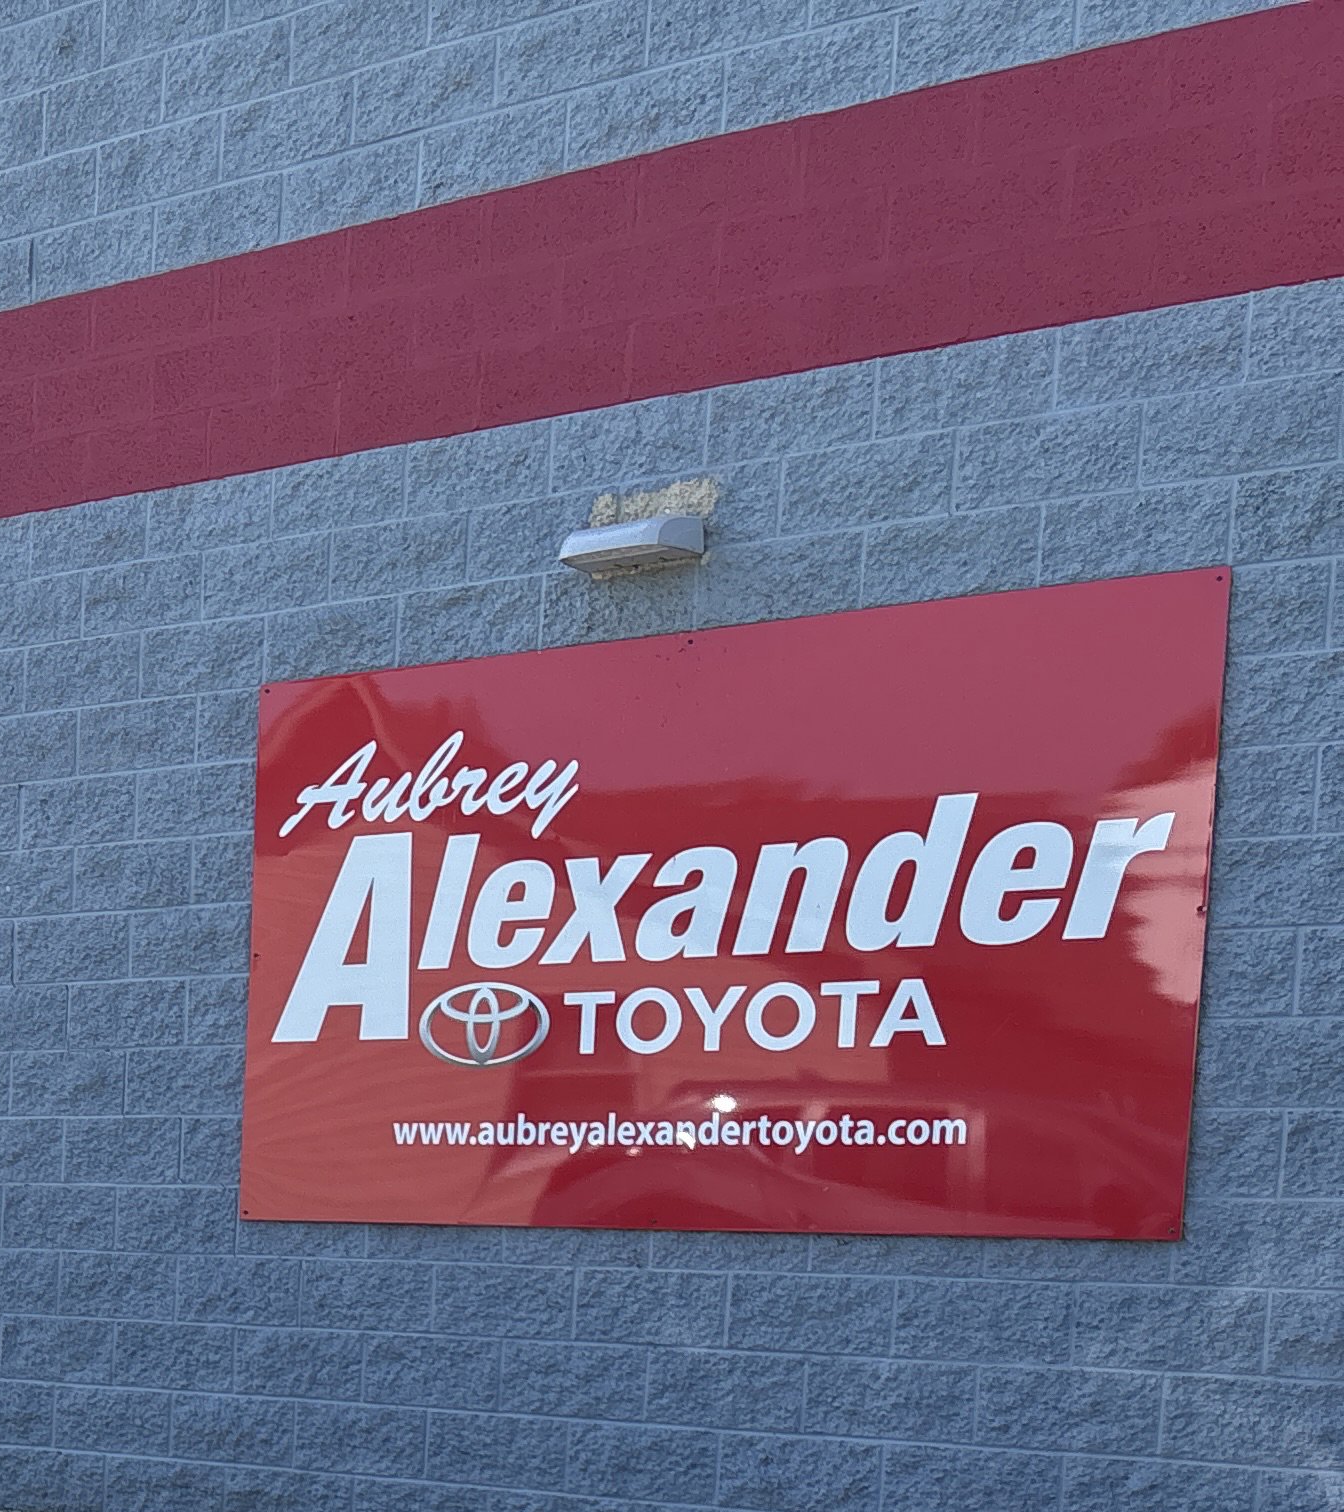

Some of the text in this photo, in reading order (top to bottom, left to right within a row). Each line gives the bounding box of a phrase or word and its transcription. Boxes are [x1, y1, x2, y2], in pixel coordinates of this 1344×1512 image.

[279, 731, 579, 839] Aubrey
[271, 792, 1176, 1043] Alexander
[564, 979, 947, 1054] TOYOTA
[393, 1111, 967, 1155] www.aubreyalexandertoyota.com
